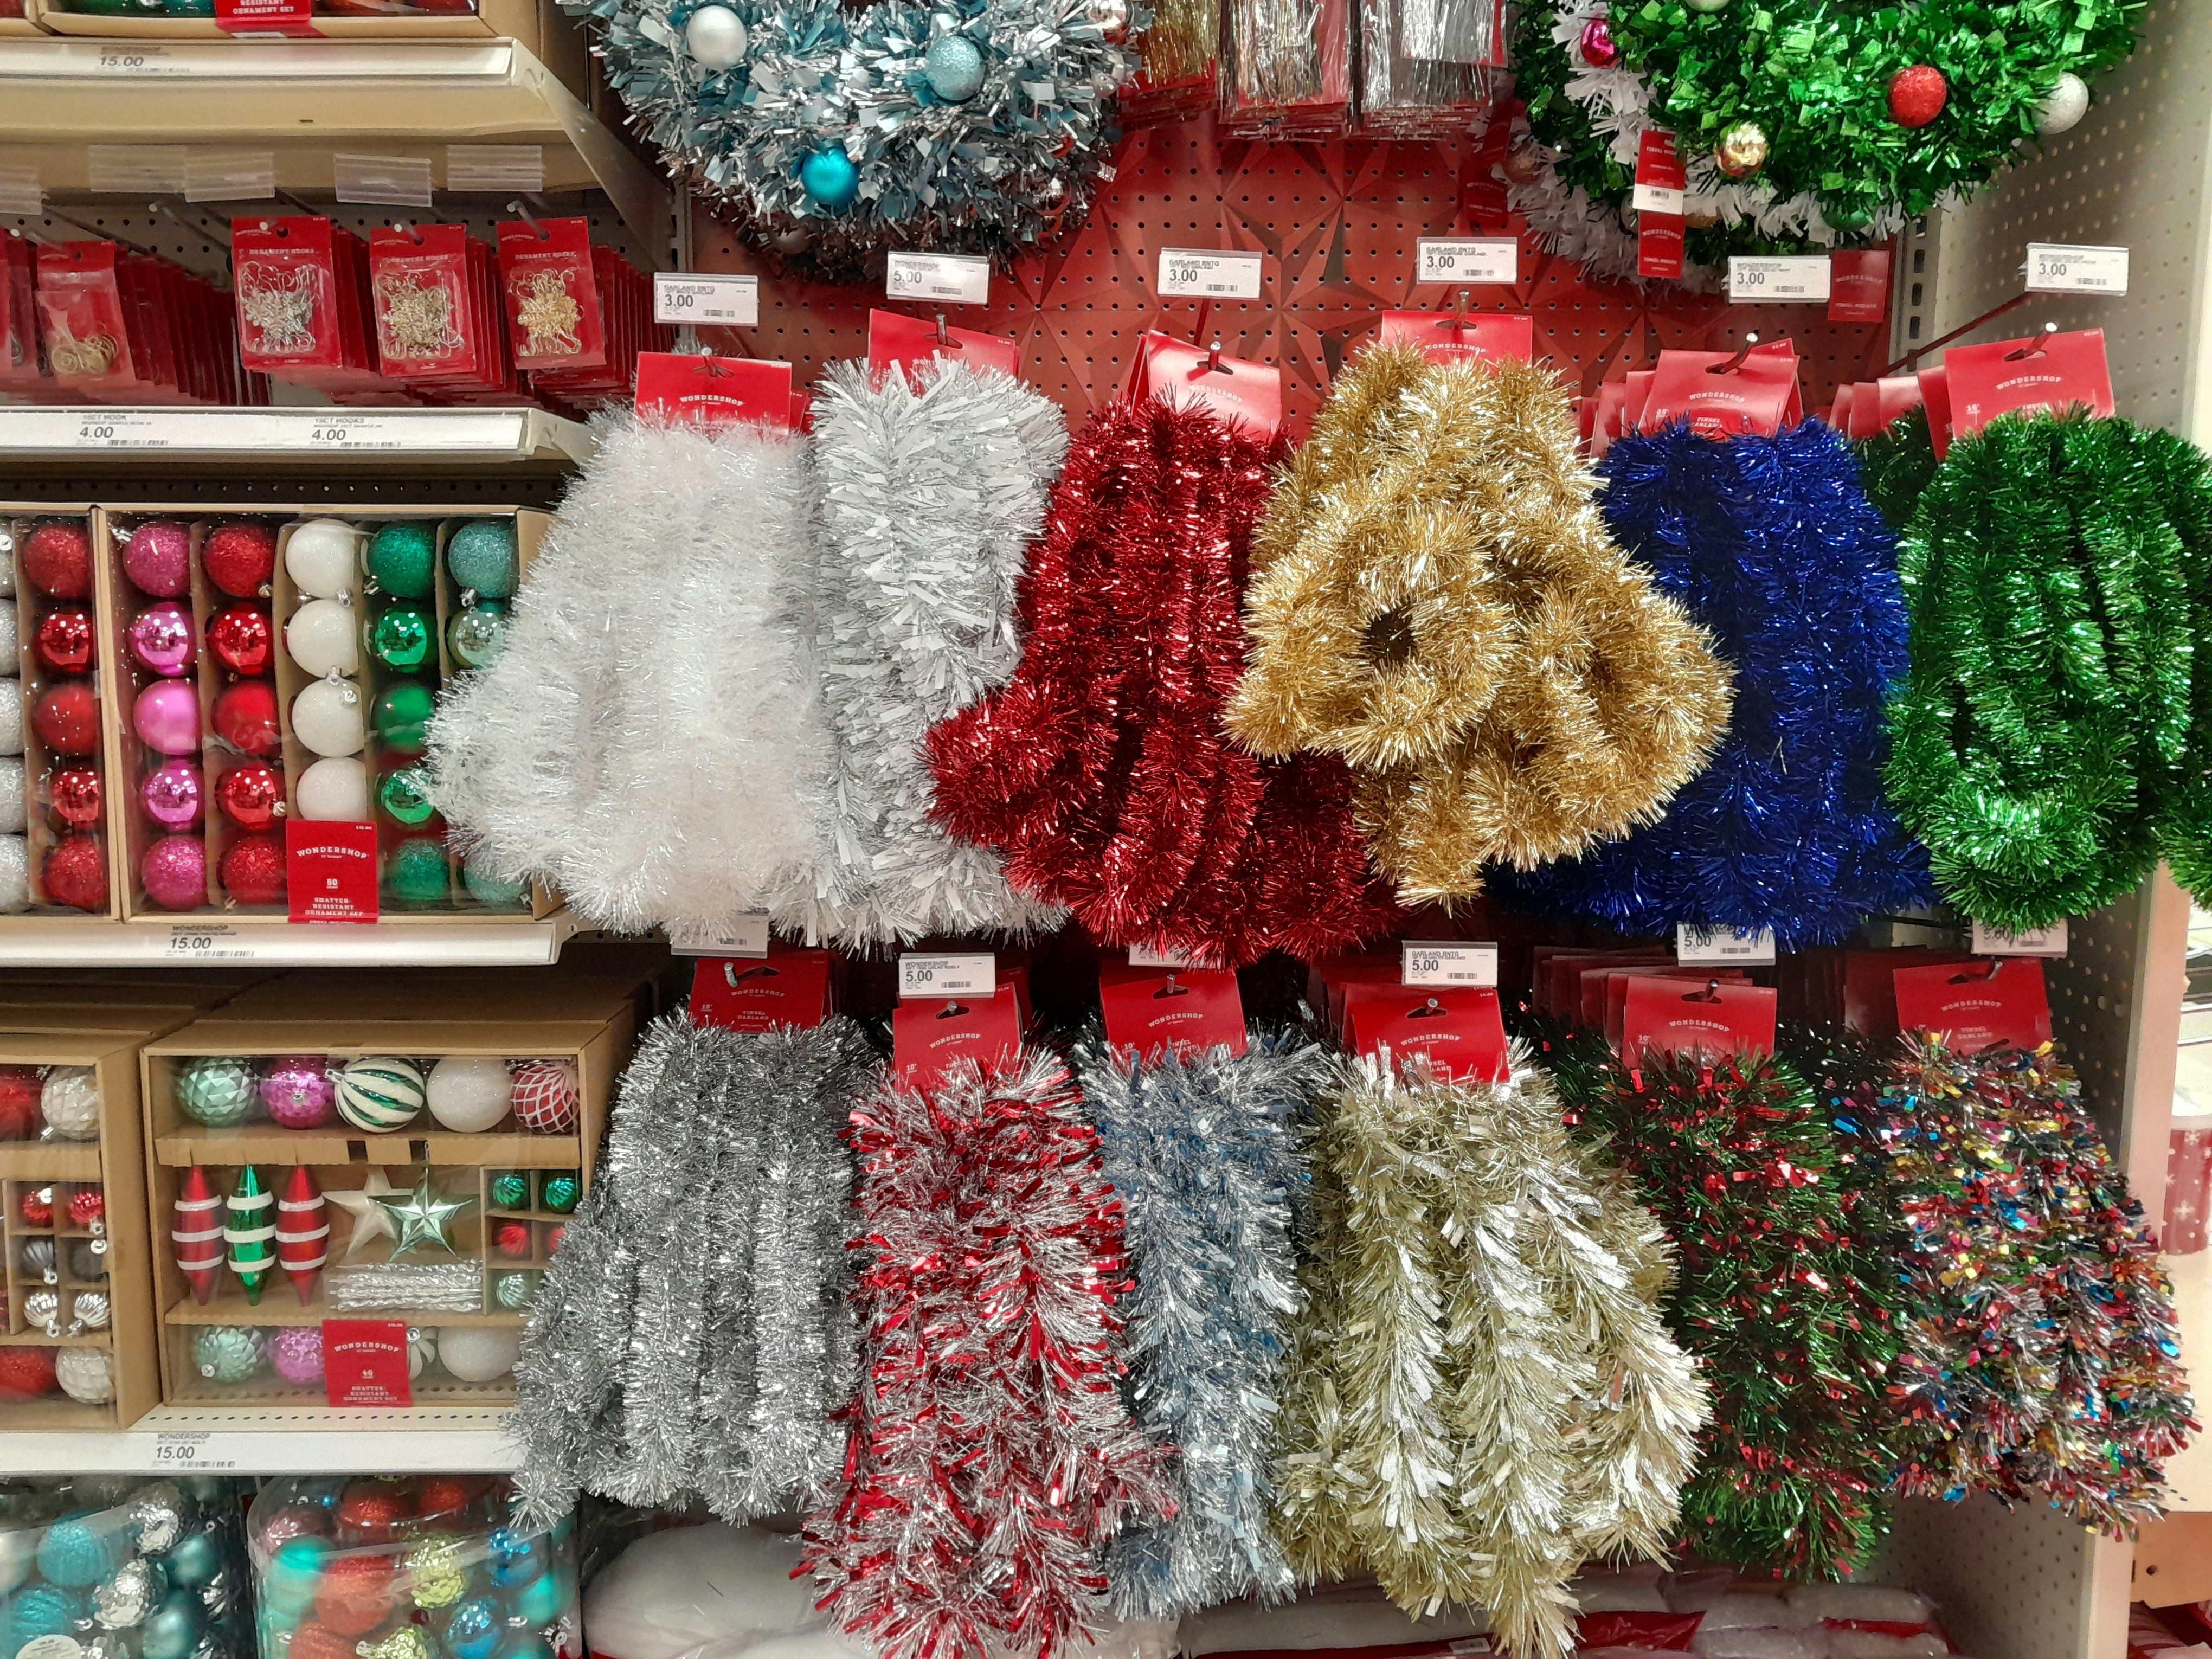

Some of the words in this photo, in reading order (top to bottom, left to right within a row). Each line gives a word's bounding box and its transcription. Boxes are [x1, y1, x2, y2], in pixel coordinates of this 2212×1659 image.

[101, 56, 144, 66] 15.00
[1426, 256, 1455, 268] 3.00
[1169, 269, 1198, 282] 3.00
[2039, 263, 2067, 276] 3.00
[893, 270, 922, 283] 5.00
[1737, 272, 1765, 284] 3.00
[665, 294, 693, 307] 3.00
[1424, 343, 1487, 353] WONDERSHOP
[1996, 375, 2061, 390] WONDERSHOP
[1188, 384, 1243, 403] WONDERSHOP
[1689, 391, 1745, 403] WONDERSHOP
[679, 394, 744, 407] WONDERSHOP
[79, 426, 114, 438] 4.00
[312, 429, 346, 440] 4.00
[295, 846, 368, 859] WONDERSHOP
[171, 937, 212, 949] 15.00
[1684, 936, 1712, 948] 5.00
[1412, 960, 1439, 972] 5.00
[905, 970, 933, 982] 5.00
[731, 989, 785, 998] WONDERSHOP
[1941, 1000, 2002, 1012] WONDERSHOP
[1148, 1012, 1204, 1027] WONDERSHOP
[1669, 1019, 1730, 1032] WONDERSHOP
[929, 1033, 981, 1049] WONDERSHOP
[1400, 1033, 1462, 1046] WONDERSHOP
[333, 1342, 400, 1352] WONDERSHOP
[156, 1446, 195, 1459] 15.00
